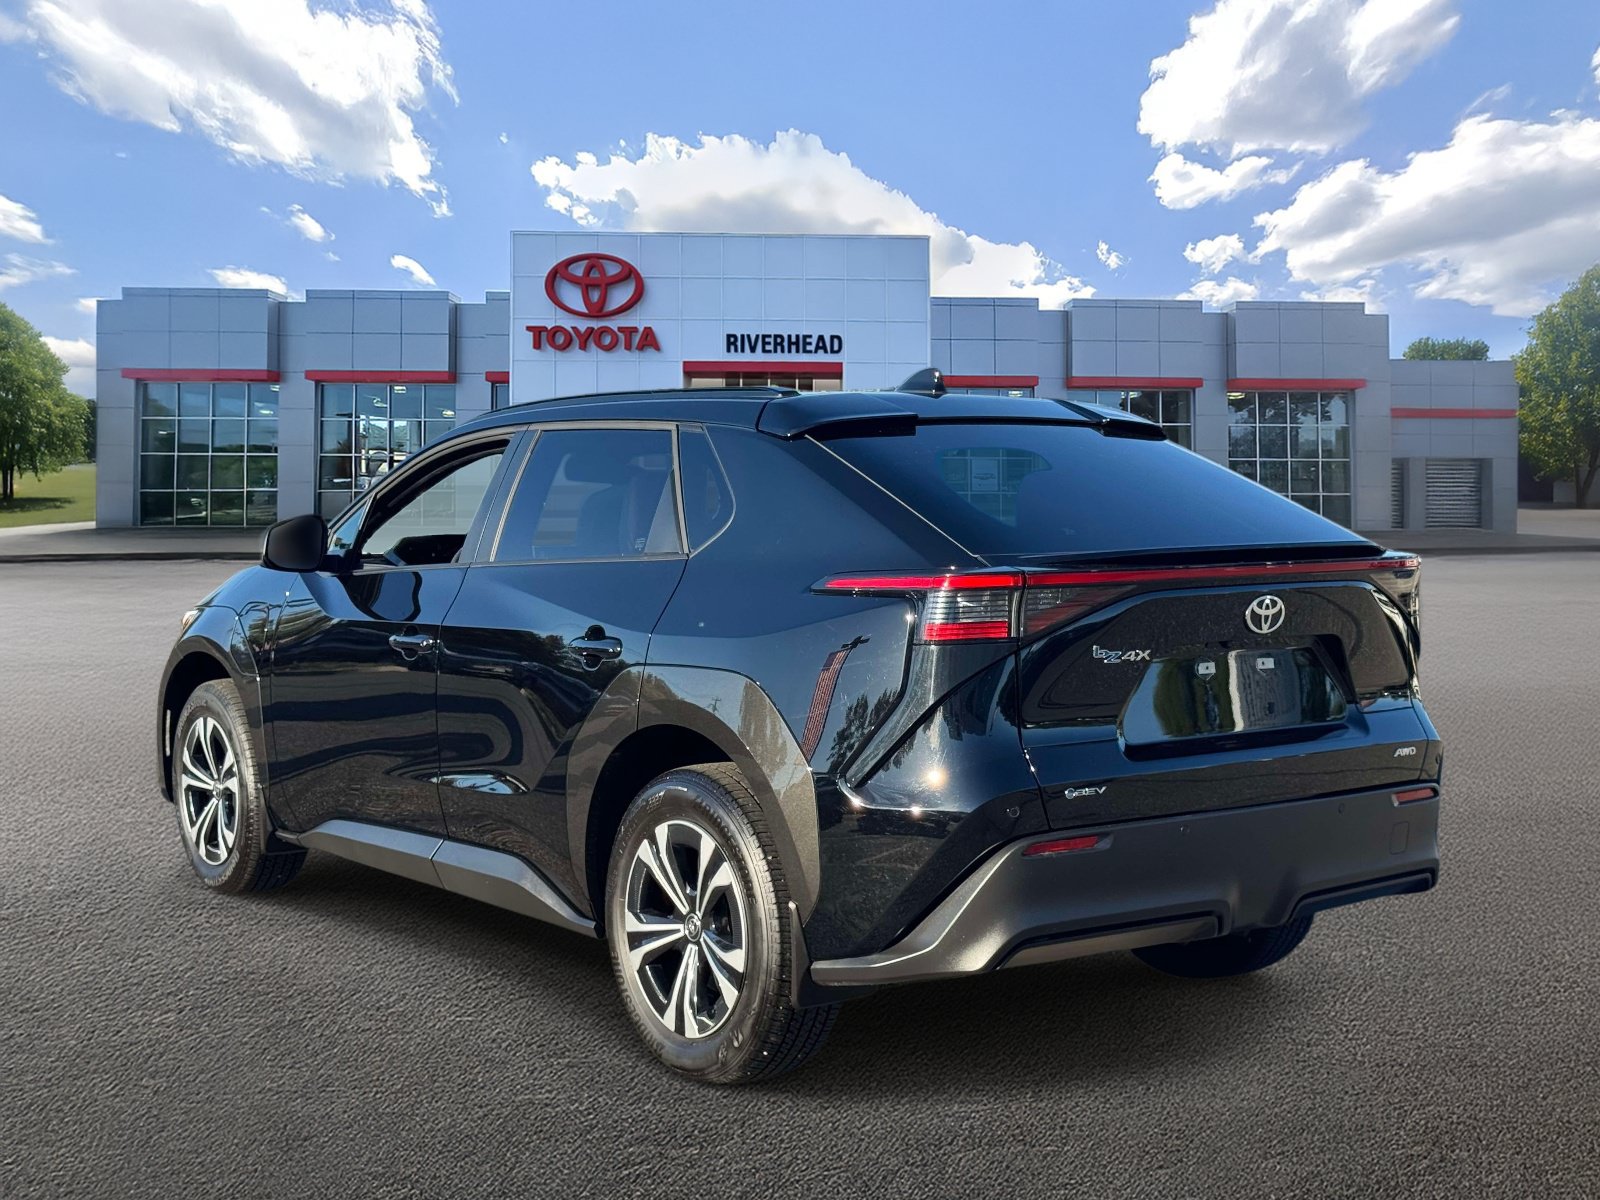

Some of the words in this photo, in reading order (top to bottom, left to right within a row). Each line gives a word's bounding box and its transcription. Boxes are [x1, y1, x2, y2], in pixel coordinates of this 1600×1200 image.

[526, 325, 661, 352] TOYOTA
[726, 333, 843, 354] RIVERHEAD
[1393, 746, 1417, 758] AWD
